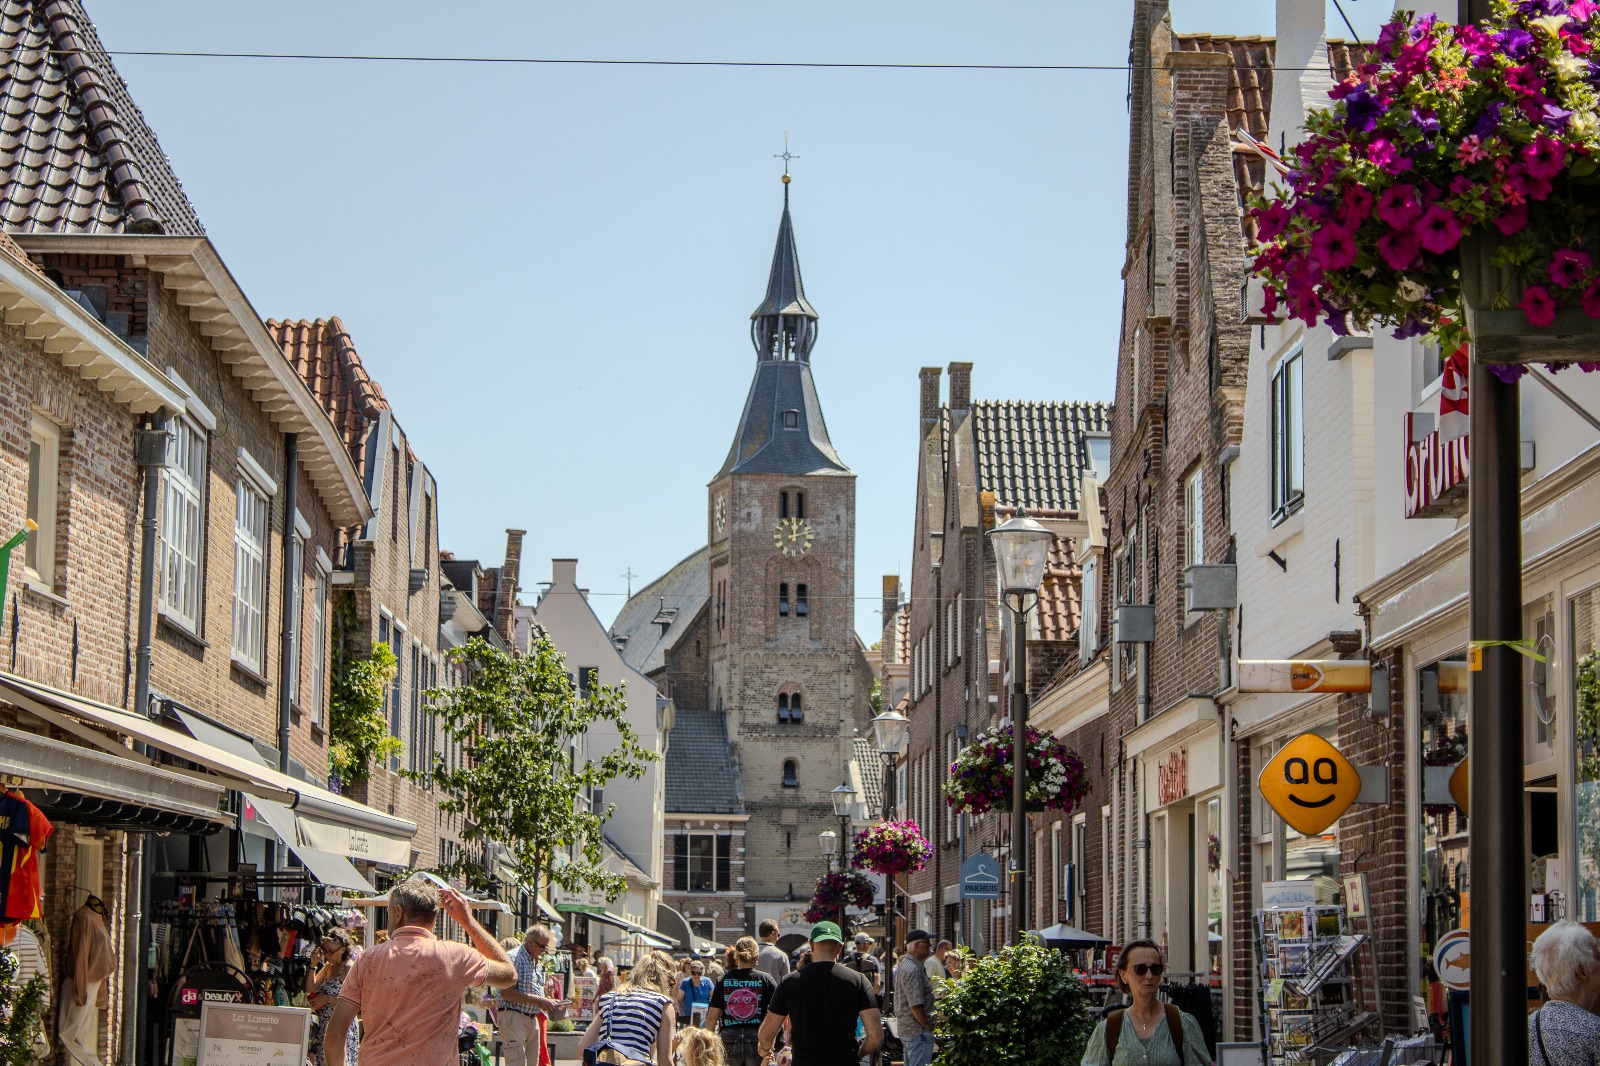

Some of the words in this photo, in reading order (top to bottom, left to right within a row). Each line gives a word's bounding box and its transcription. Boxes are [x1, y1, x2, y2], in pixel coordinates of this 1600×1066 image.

[965, 884, 999, 892] PAKHUIS
[232, 1013, 245, 1022] La
[247, 1014, 280, 1025] Lorette
